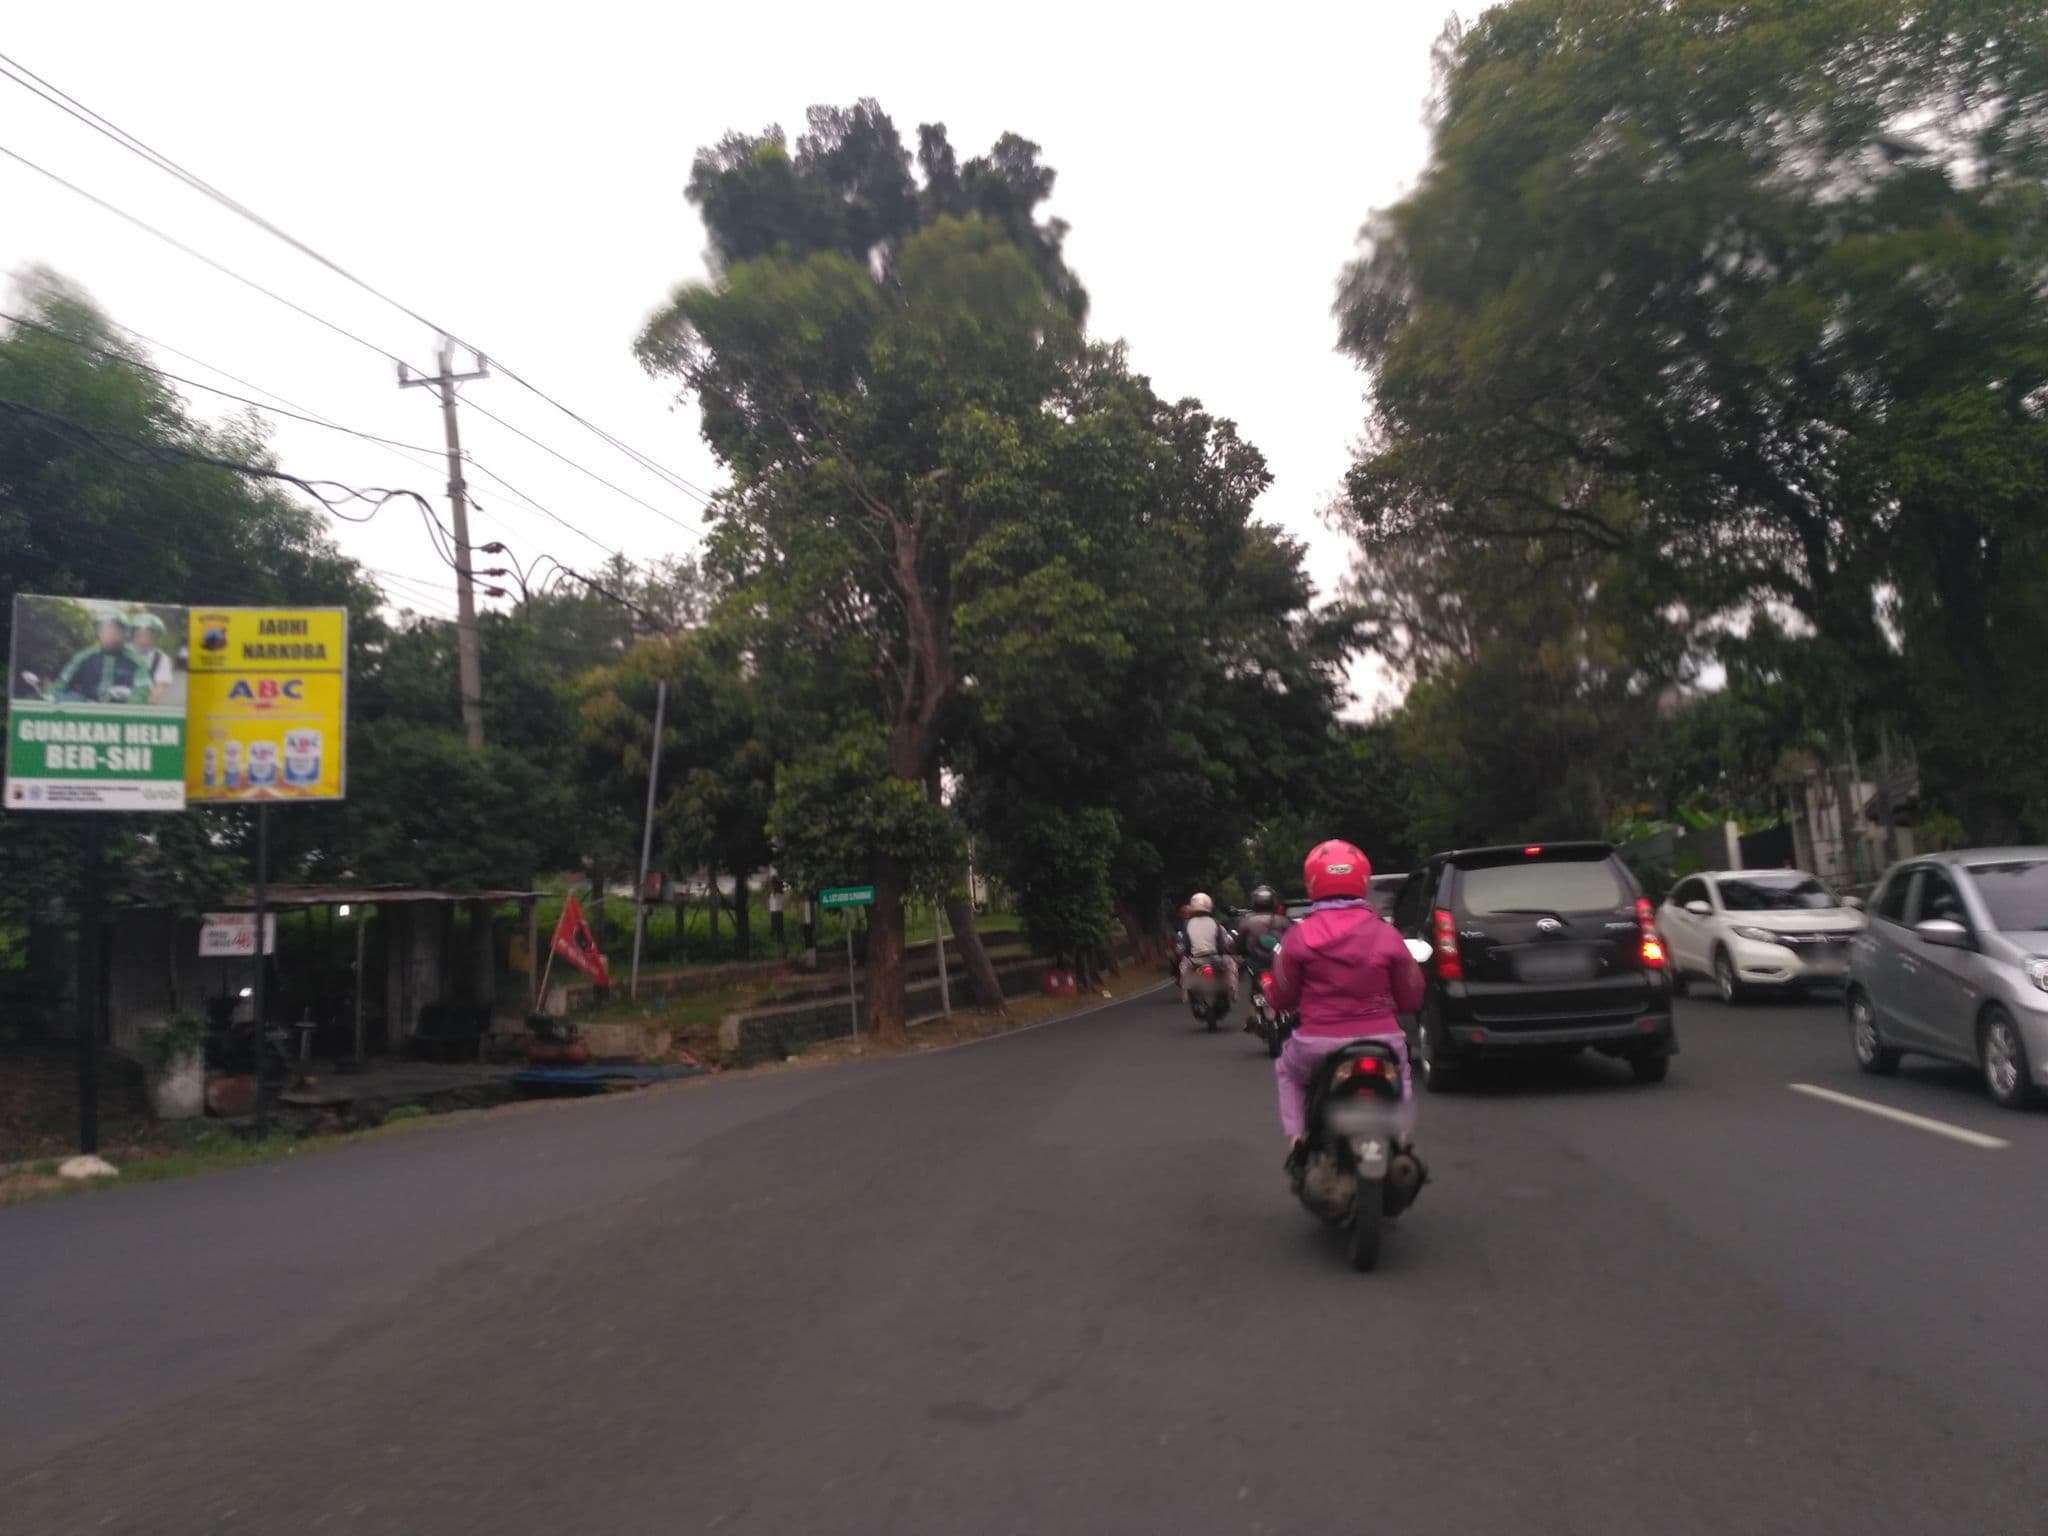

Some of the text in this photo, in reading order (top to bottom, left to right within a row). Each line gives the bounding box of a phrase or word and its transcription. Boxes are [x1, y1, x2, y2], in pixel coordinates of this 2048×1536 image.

[258, 618, 308, 636] JAUHI
[242, 643, 326, 660] NARKOBA
[228, 679, 305, 700] ABC
[17, 719, 180, 746] GUNAKAN HELM
[45, 744, 153, 771] BER-SNI
